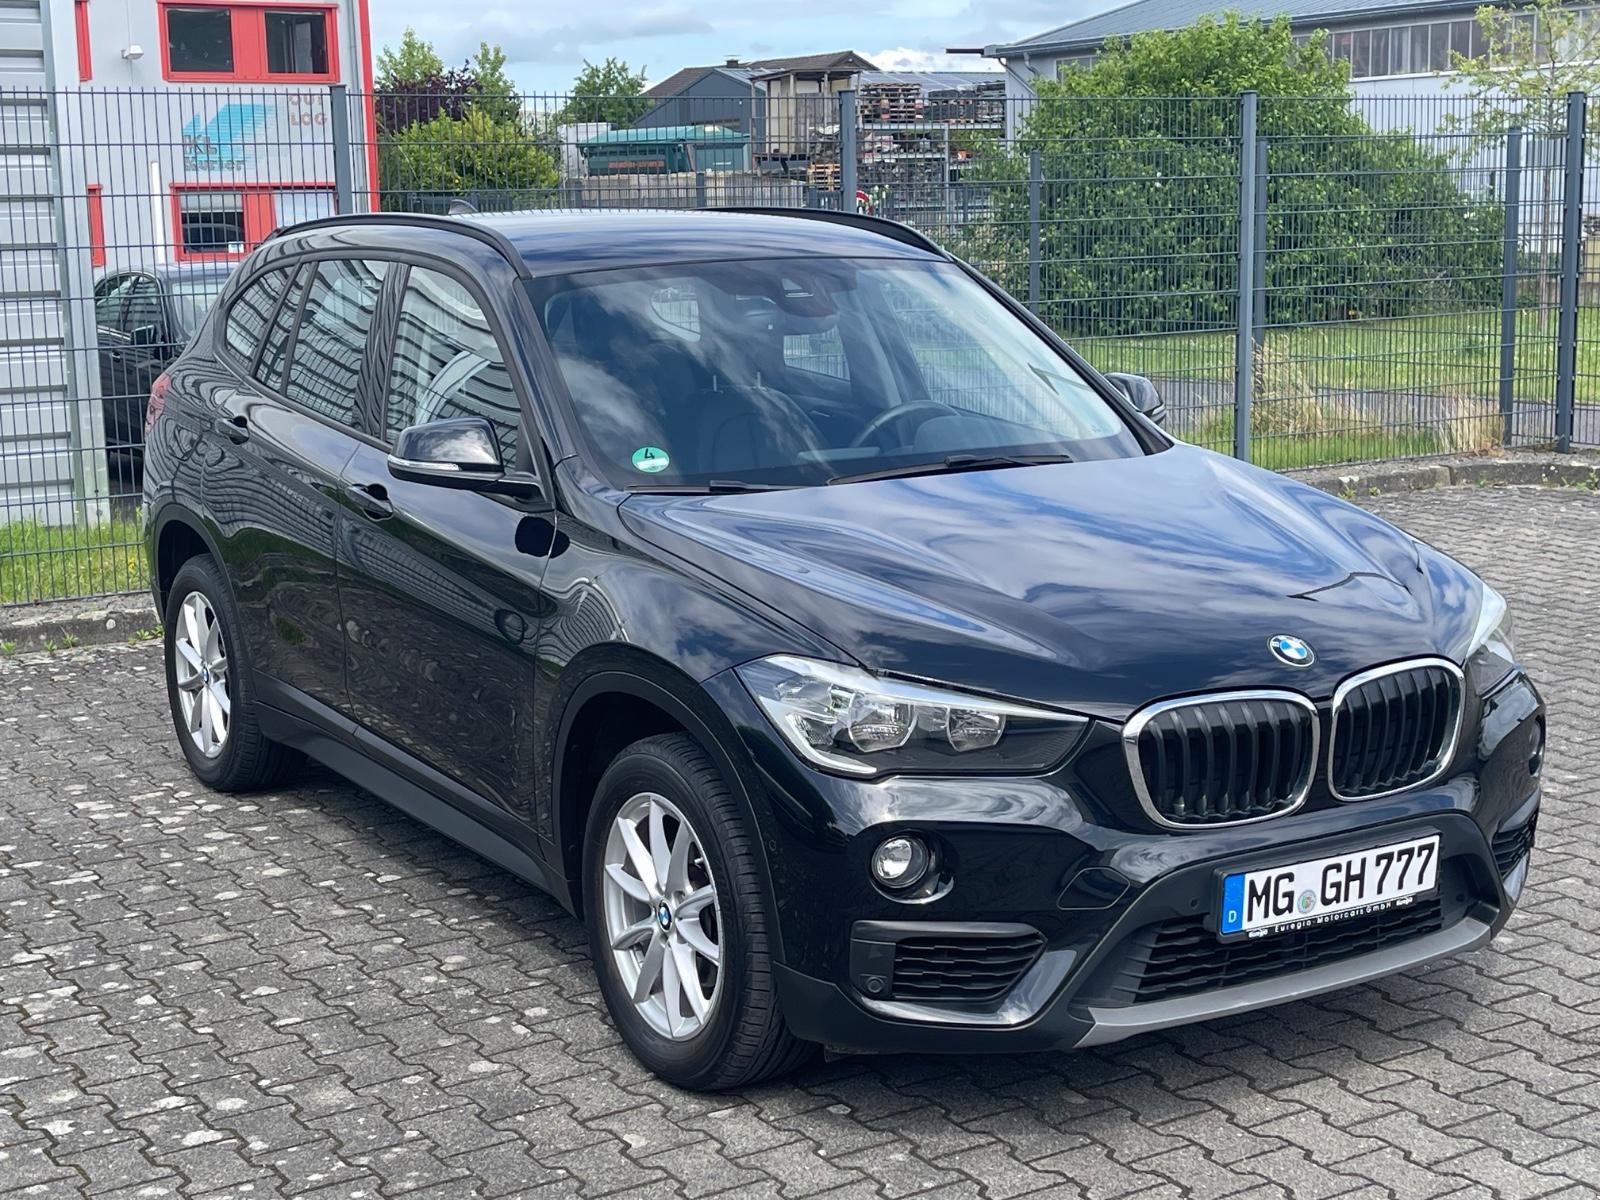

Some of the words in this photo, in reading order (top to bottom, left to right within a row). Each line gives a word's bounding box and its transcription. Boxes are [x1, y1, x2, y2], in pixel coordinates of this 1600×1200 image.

[644, 448, 656, 459] 4
[1247, 872, 1295, 922] MG
[1228, 910, 1237, 923] D
